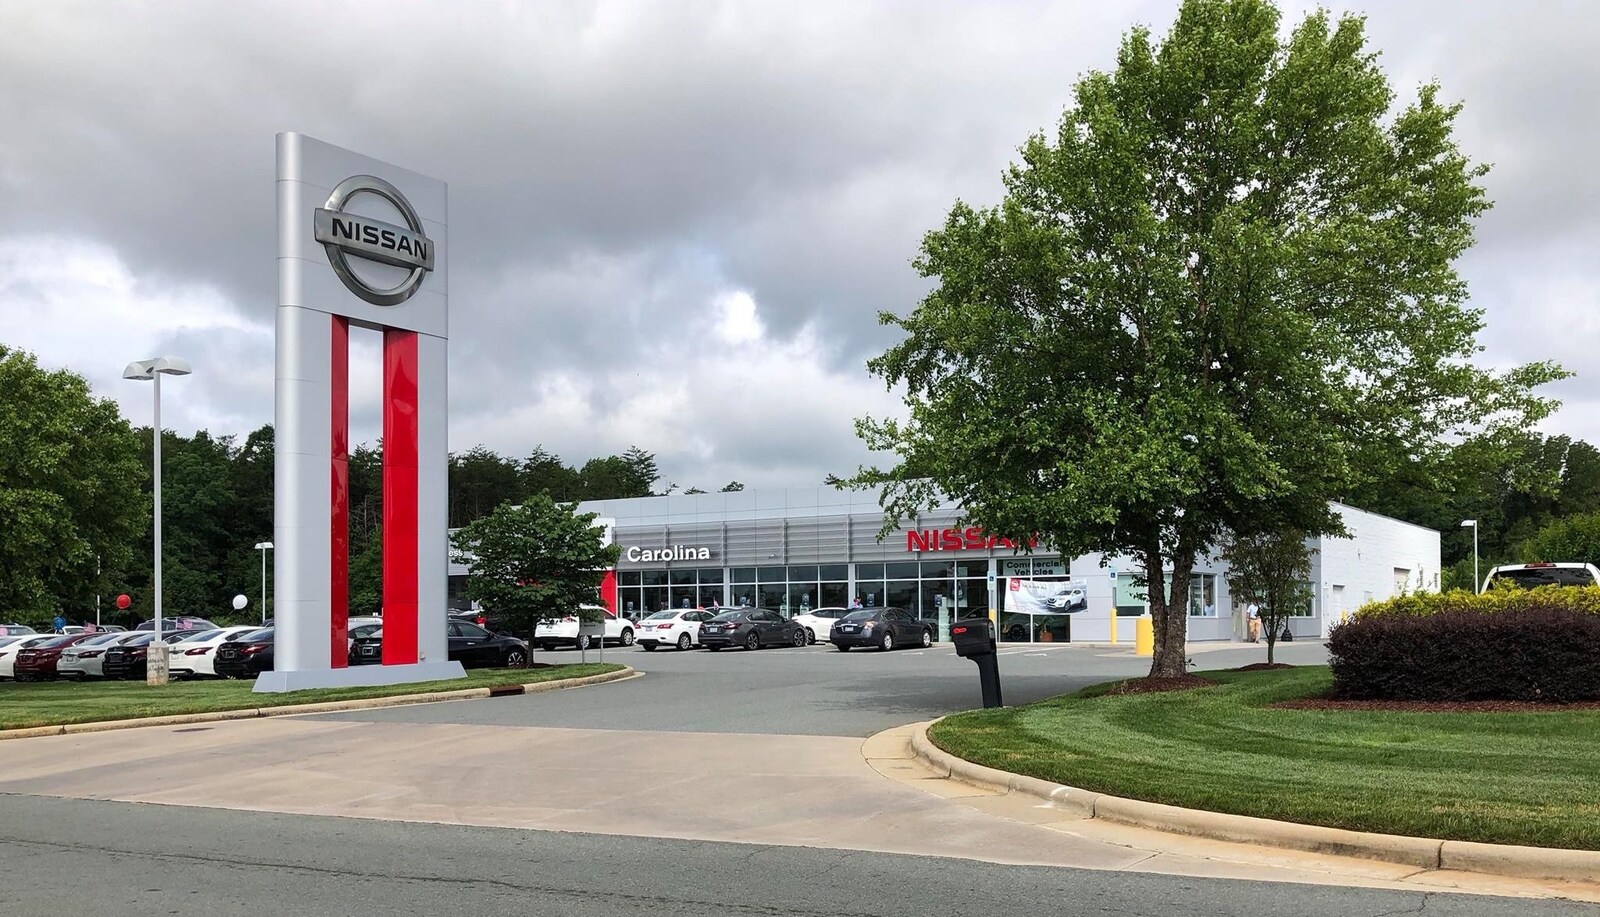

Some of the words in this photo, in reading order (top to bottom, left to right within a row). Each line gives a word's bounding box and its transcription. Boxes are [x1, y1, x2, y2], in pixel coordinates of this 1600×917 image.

[331, 218, 427, 260] NISSAN
[627, 545, 710, 562] Carolina
[1014, 568, 1054, 576] Vehcles
